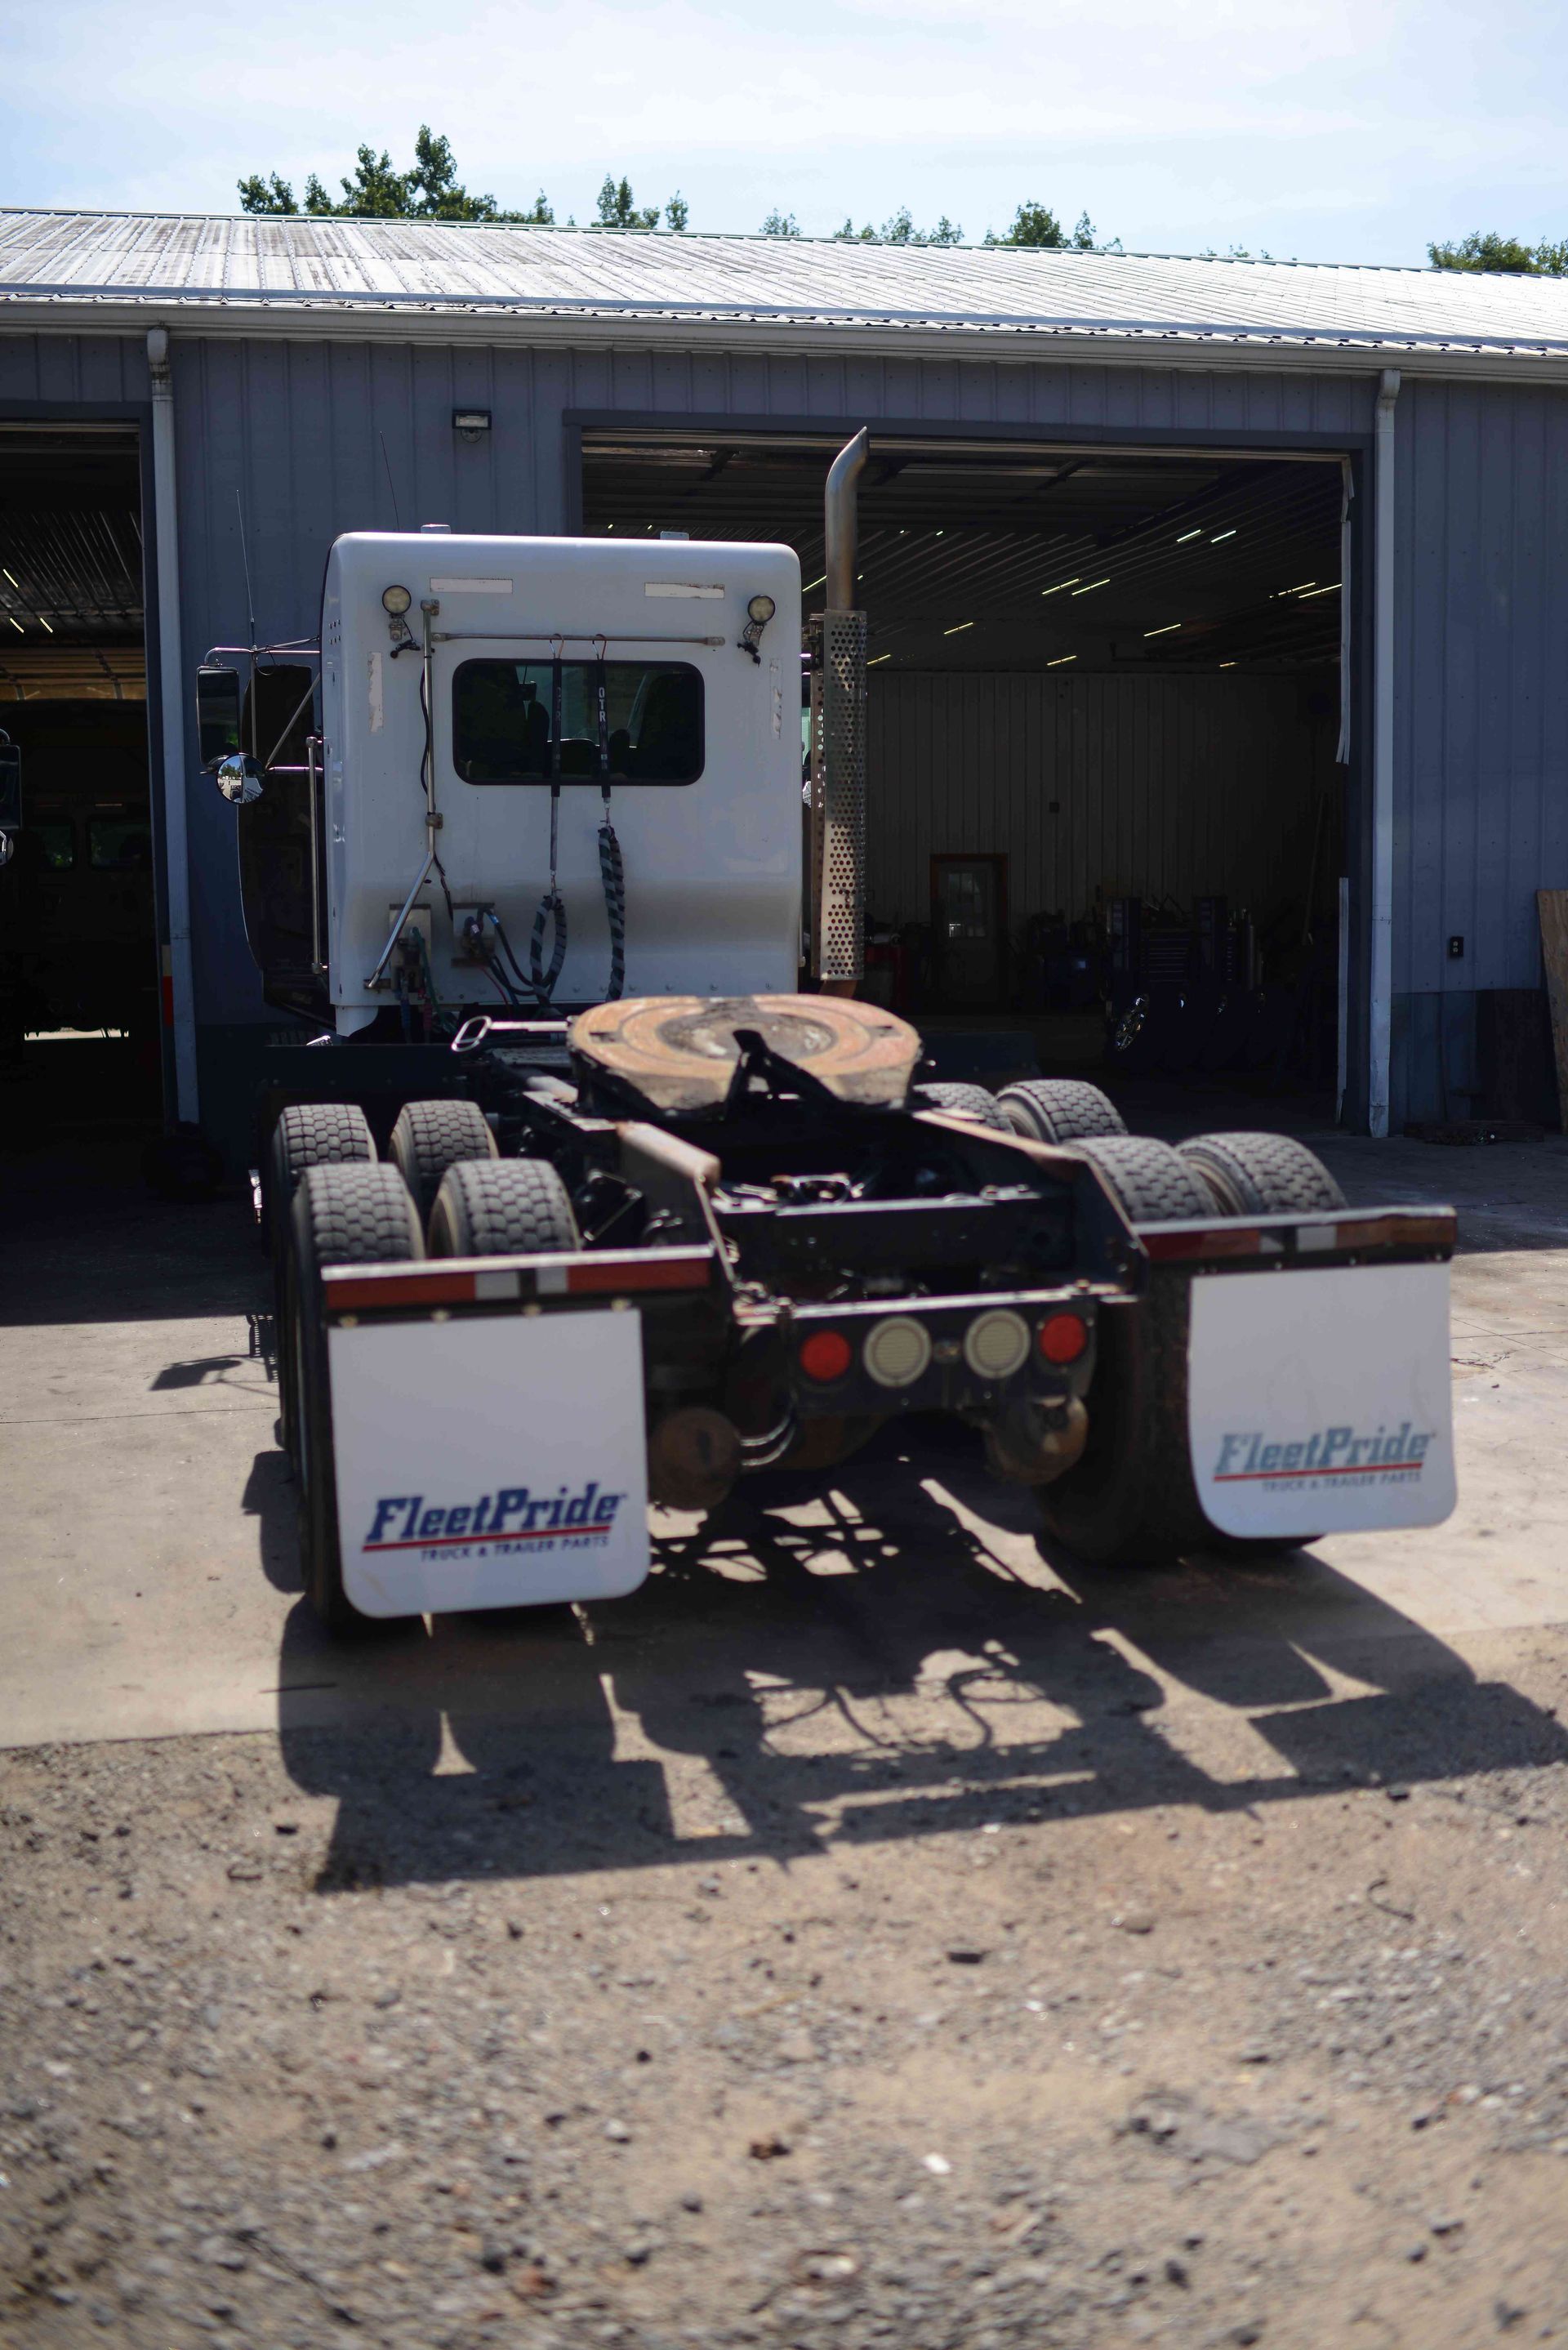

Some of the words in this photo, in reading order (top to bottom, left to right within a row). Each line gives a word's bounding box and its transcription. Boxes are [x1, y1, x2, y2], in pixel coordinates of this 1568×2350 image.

[1215, 1422, 1430, 1474] FleetPride
[1263, 1480, 1303, 1492] TRUCK
[1324, 1474, 1375, 1488] TRAILER
[1380, 1471, 1422, 1484] PARTS
[365, 1482, 621, 1542] FleetPride
[421, 1548, 470, 1562] TRUCK
[478, 1545, 488, 1558] &
[494, 1540, 555, 1556] TRAILER
[560, 1536, 608, 1550] PARTS
